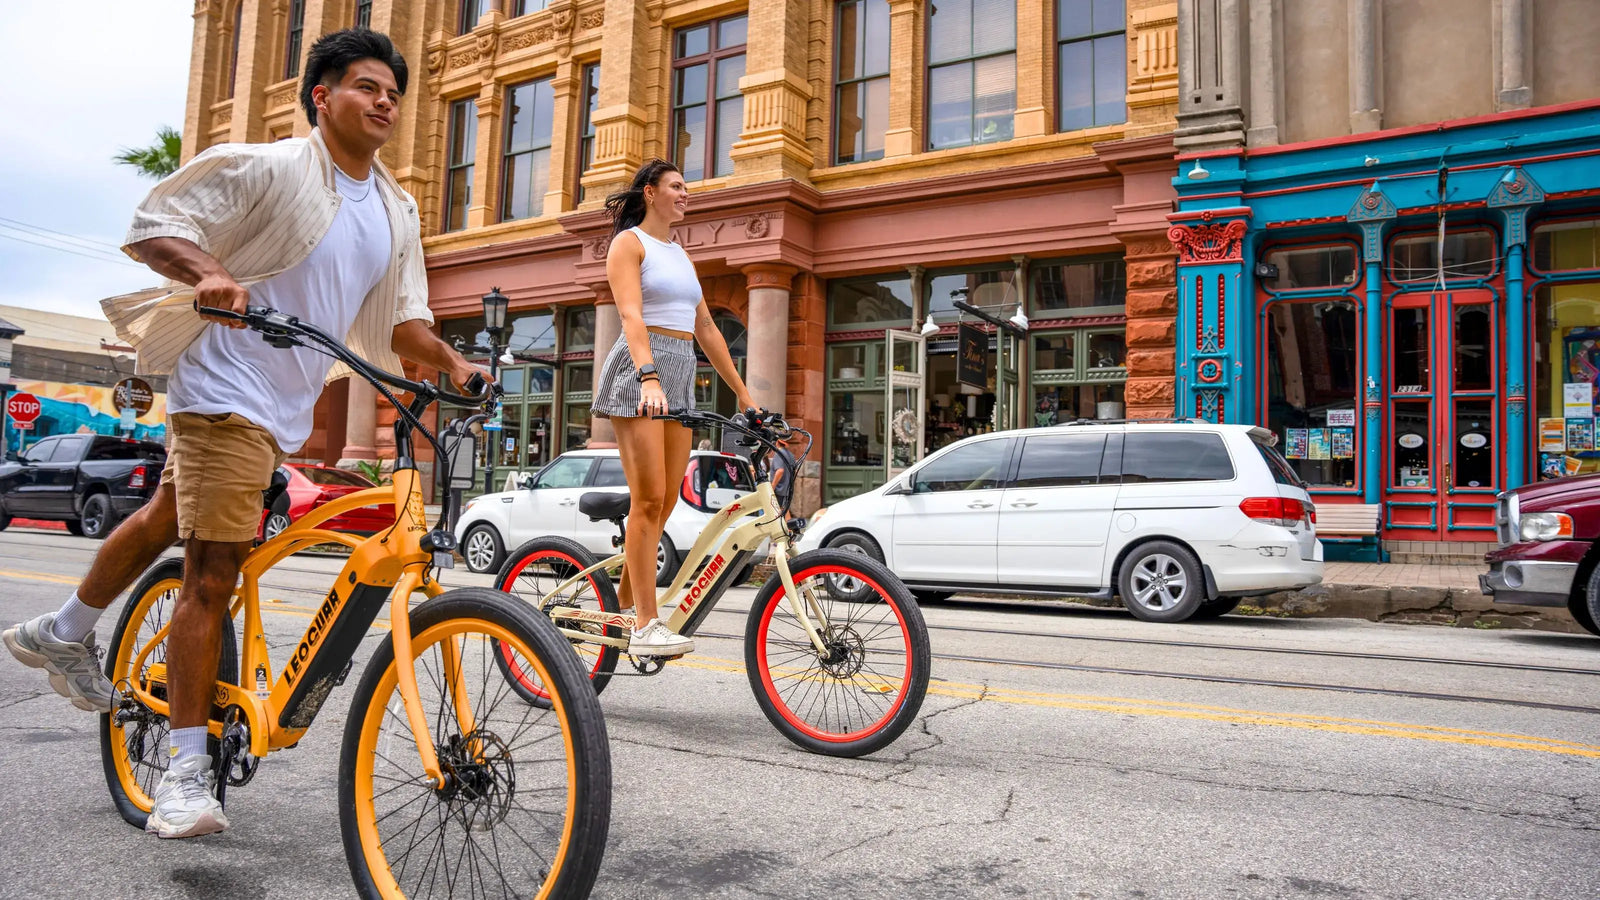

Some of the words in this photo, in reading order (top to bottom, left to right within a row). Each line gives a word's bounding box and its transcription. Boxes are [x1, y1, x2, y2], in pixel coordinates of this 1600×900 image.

[670, 222, 725, 248] ALY
[1396, 384, 1422, 393] 2314
[9, 401, 40, 414] STOP
